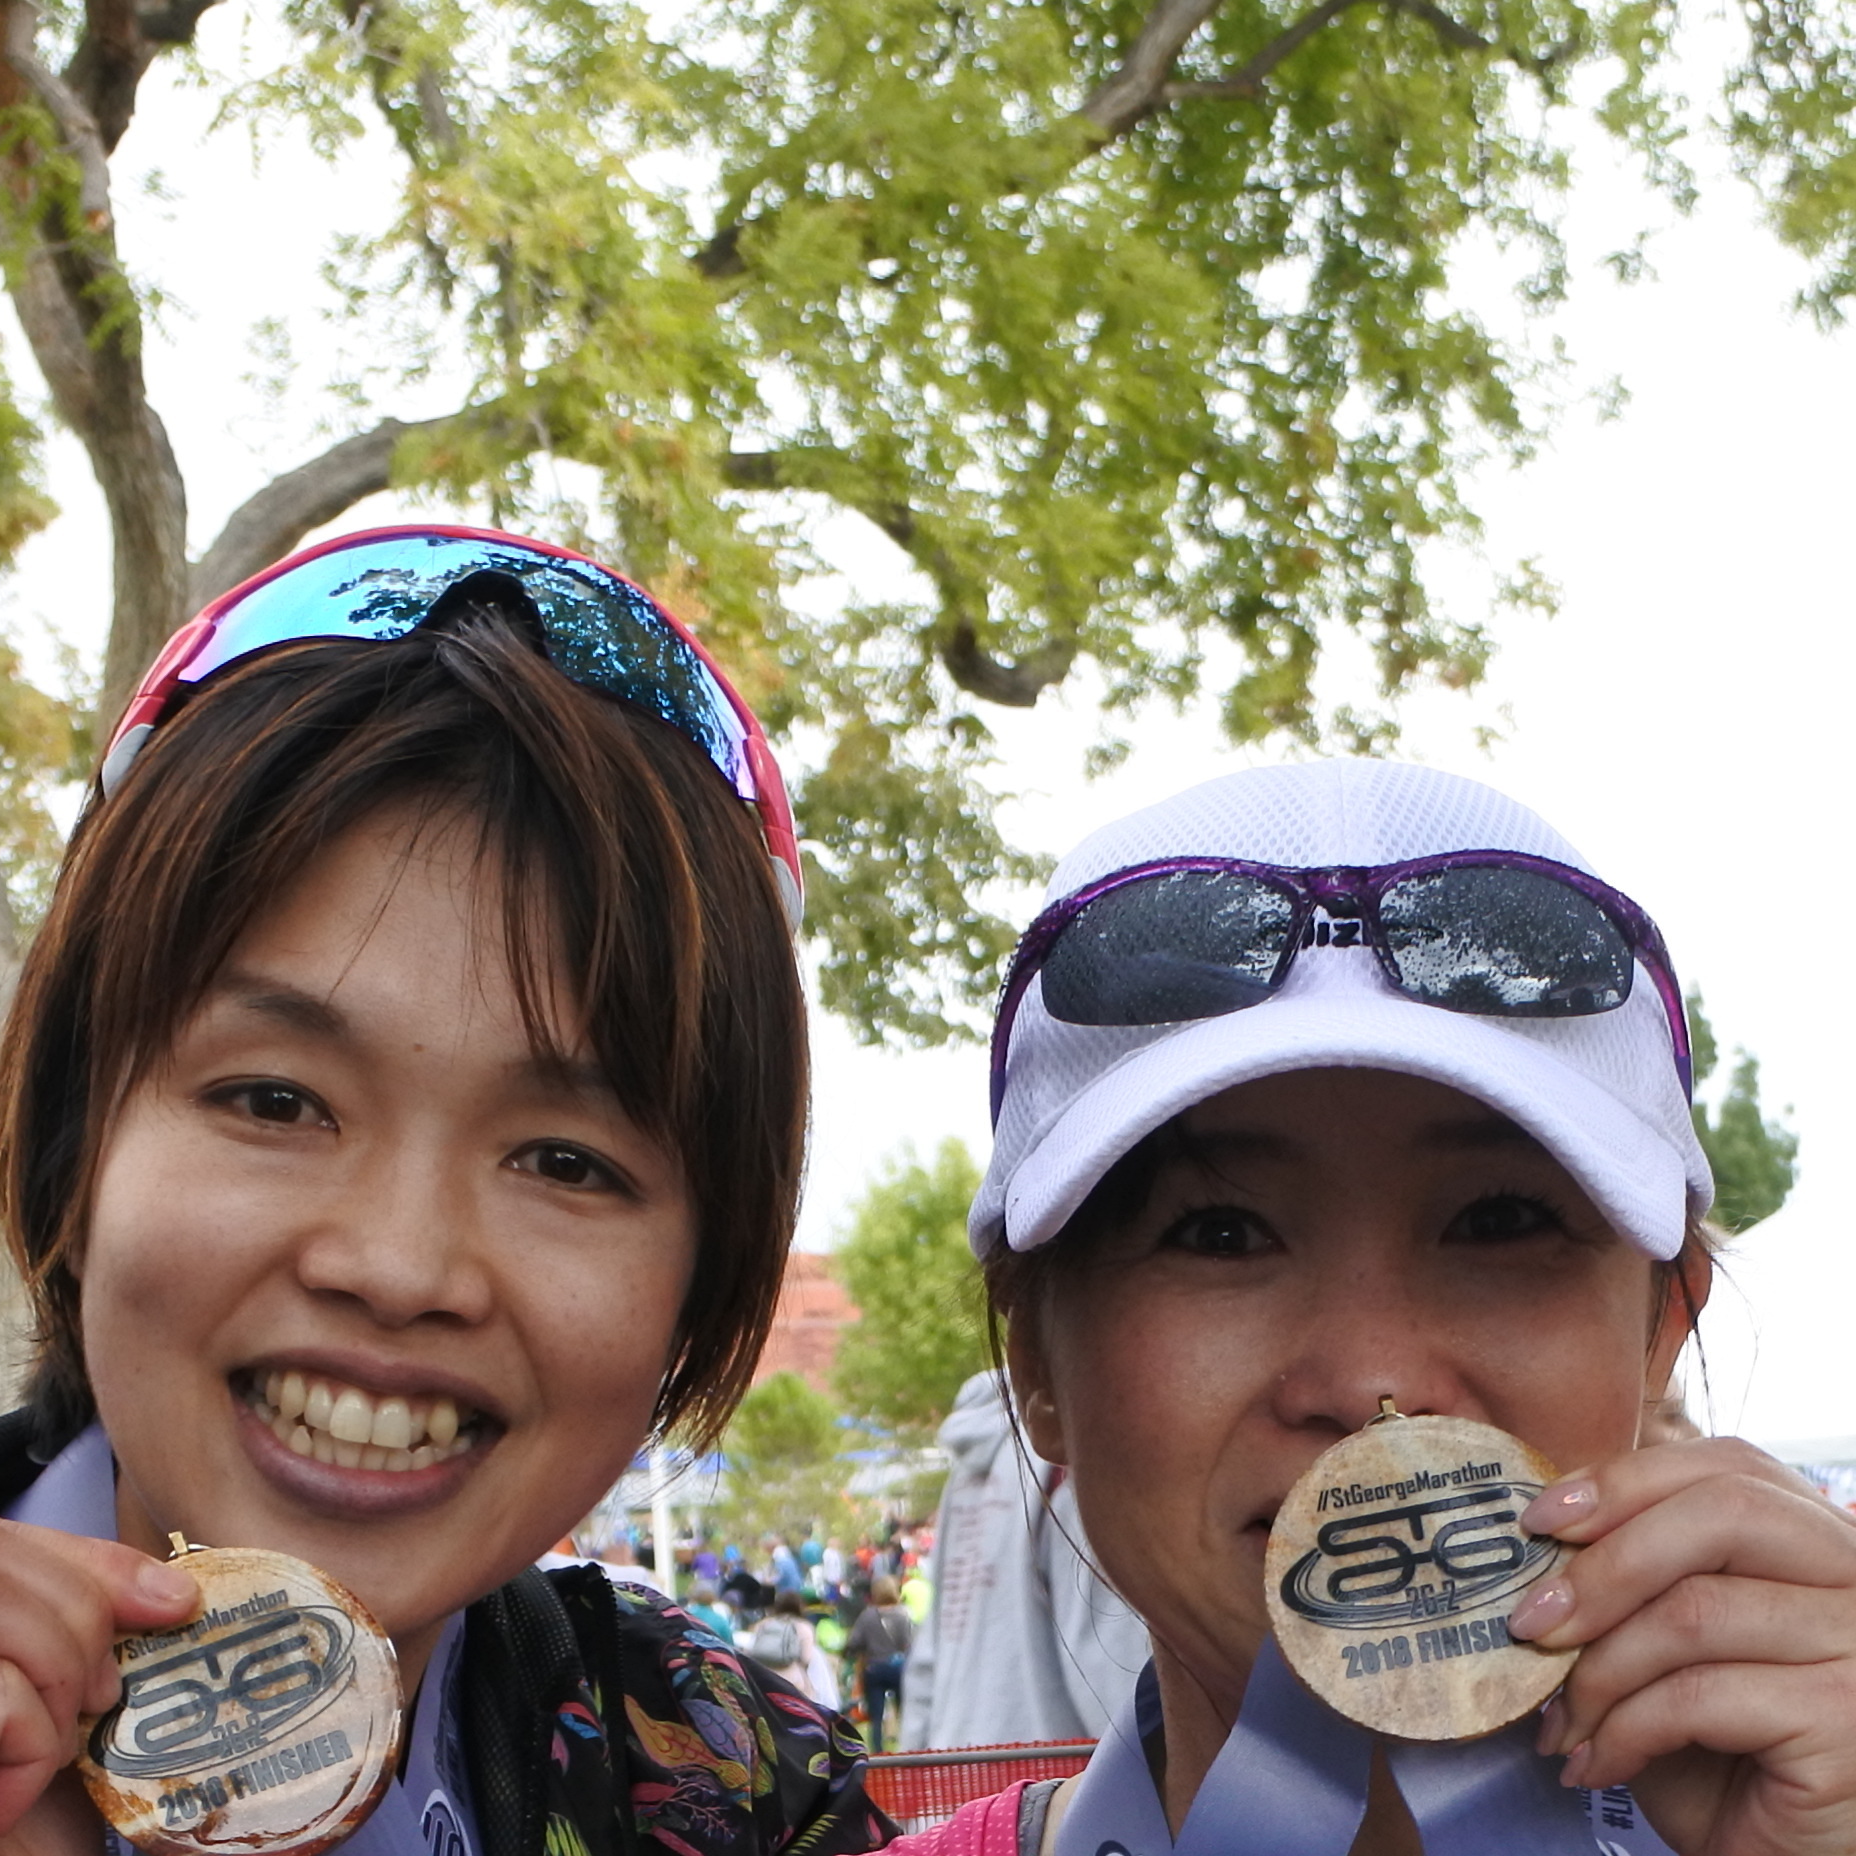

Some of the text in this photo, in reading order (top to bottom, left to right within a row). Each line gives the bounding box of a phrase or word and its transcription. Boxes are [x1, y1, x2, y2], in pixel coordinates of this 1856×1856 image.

[1341, 1616, 1514, 1679] 2018 FINISH
[157, 1729, 354, 1827] 2018 FINISHER
